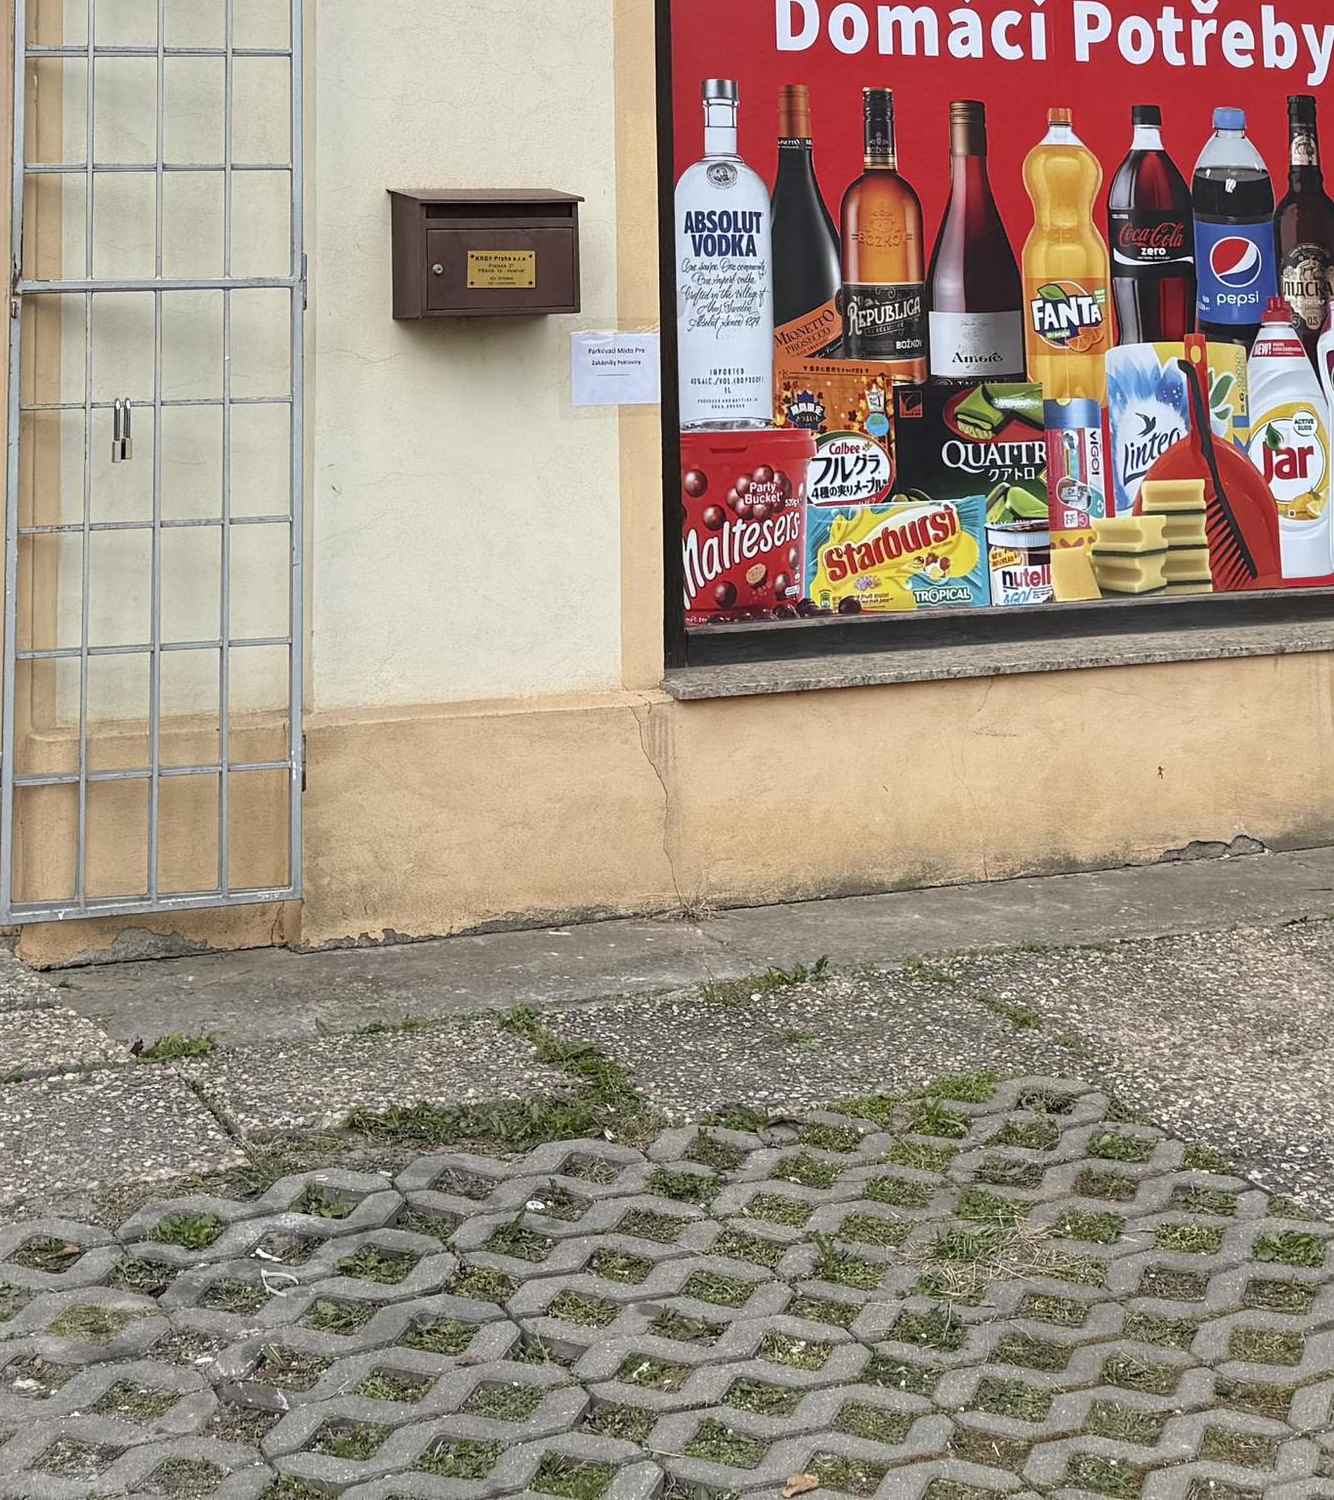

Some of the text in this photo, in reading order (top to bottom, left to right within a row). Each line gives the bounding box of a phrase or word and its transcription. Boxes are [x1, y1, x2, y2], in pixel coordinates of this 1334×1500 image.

[684, 210, 762, 234] ABSOLUT
[691, 234, 757, 257] VODKA
[1141, 248, 1166, 256] zero
[1217, 290, 1259, 307] pepsi
[847, 296, 921, 336] REPUBLICA
[1031, 296, 1102, 331] FANTA
[775, 309, 835, 347] MIONETTO
[785, 327, 831, 355] PROSECCO
[709, 368, 745, 376] IMPORTED
[829, 442, 860, 455] Calbee
[942, 440, 1046, 473] QUATTR
[811, 454, 881, 486] フルグラ
[988, 467, 1035, 482] クアトロ
[744, 492, 779, 505] Bucket
[749, 482, 776, 495] Party
[824, 504, 957, 582] Starburst
[1003, 566, 1051, 588] nutell
[915, 588, 971, 603] TROPICAL
